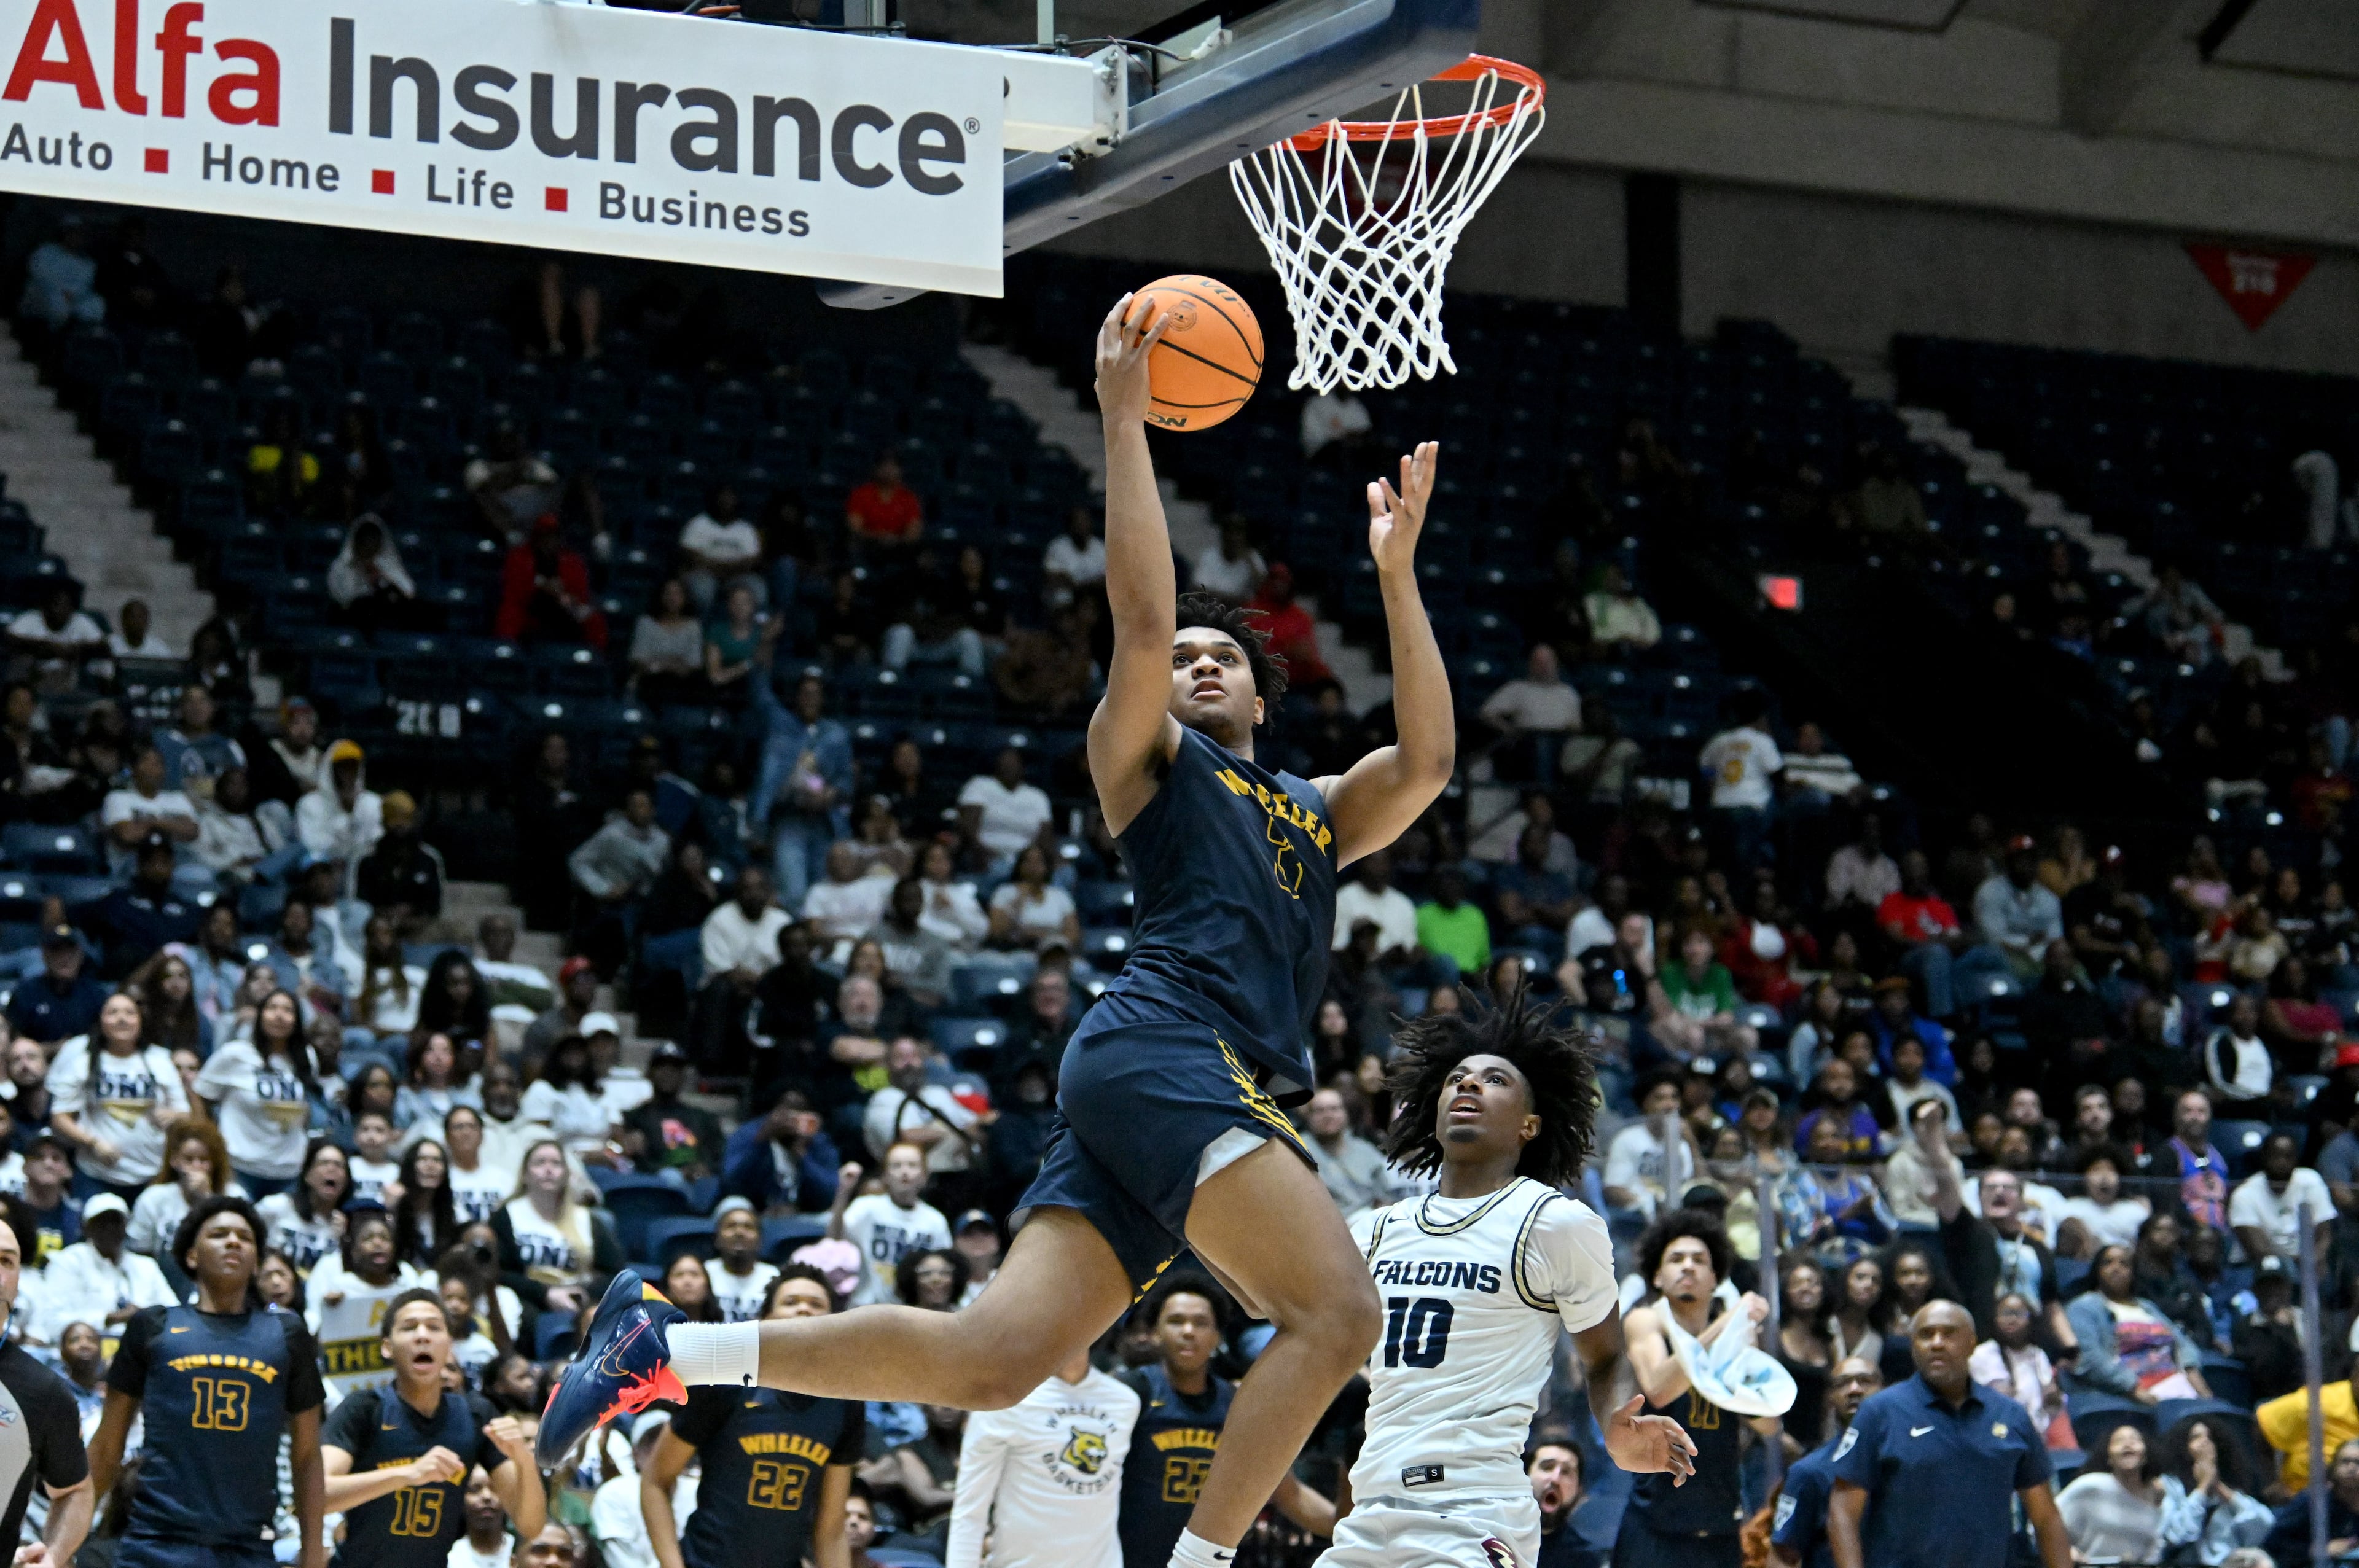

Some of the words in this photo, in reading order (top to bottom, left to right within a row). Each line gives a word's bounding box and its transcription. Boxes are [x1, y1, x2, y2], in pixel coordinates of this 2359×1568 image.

[2, 0, 281, 127] Alfa
[0, 122, 113, 171] Auto
[203, 142, 340, 192] Home
[428, 164, 514, 209] Life
[599, 182, 810, 237] Business
[1214, 768, 1332, 857] WEELER
[1373, 1260, 1501, 1295] FALCONS
[1383, 1297, 1455, 1369] 10
[192, 1376, 251, 1432] 13
[746, 1459, 811, 1511] 22
[1431, 1469, 1438, 1477] S
[389, 1486, 445, 1537] 15
